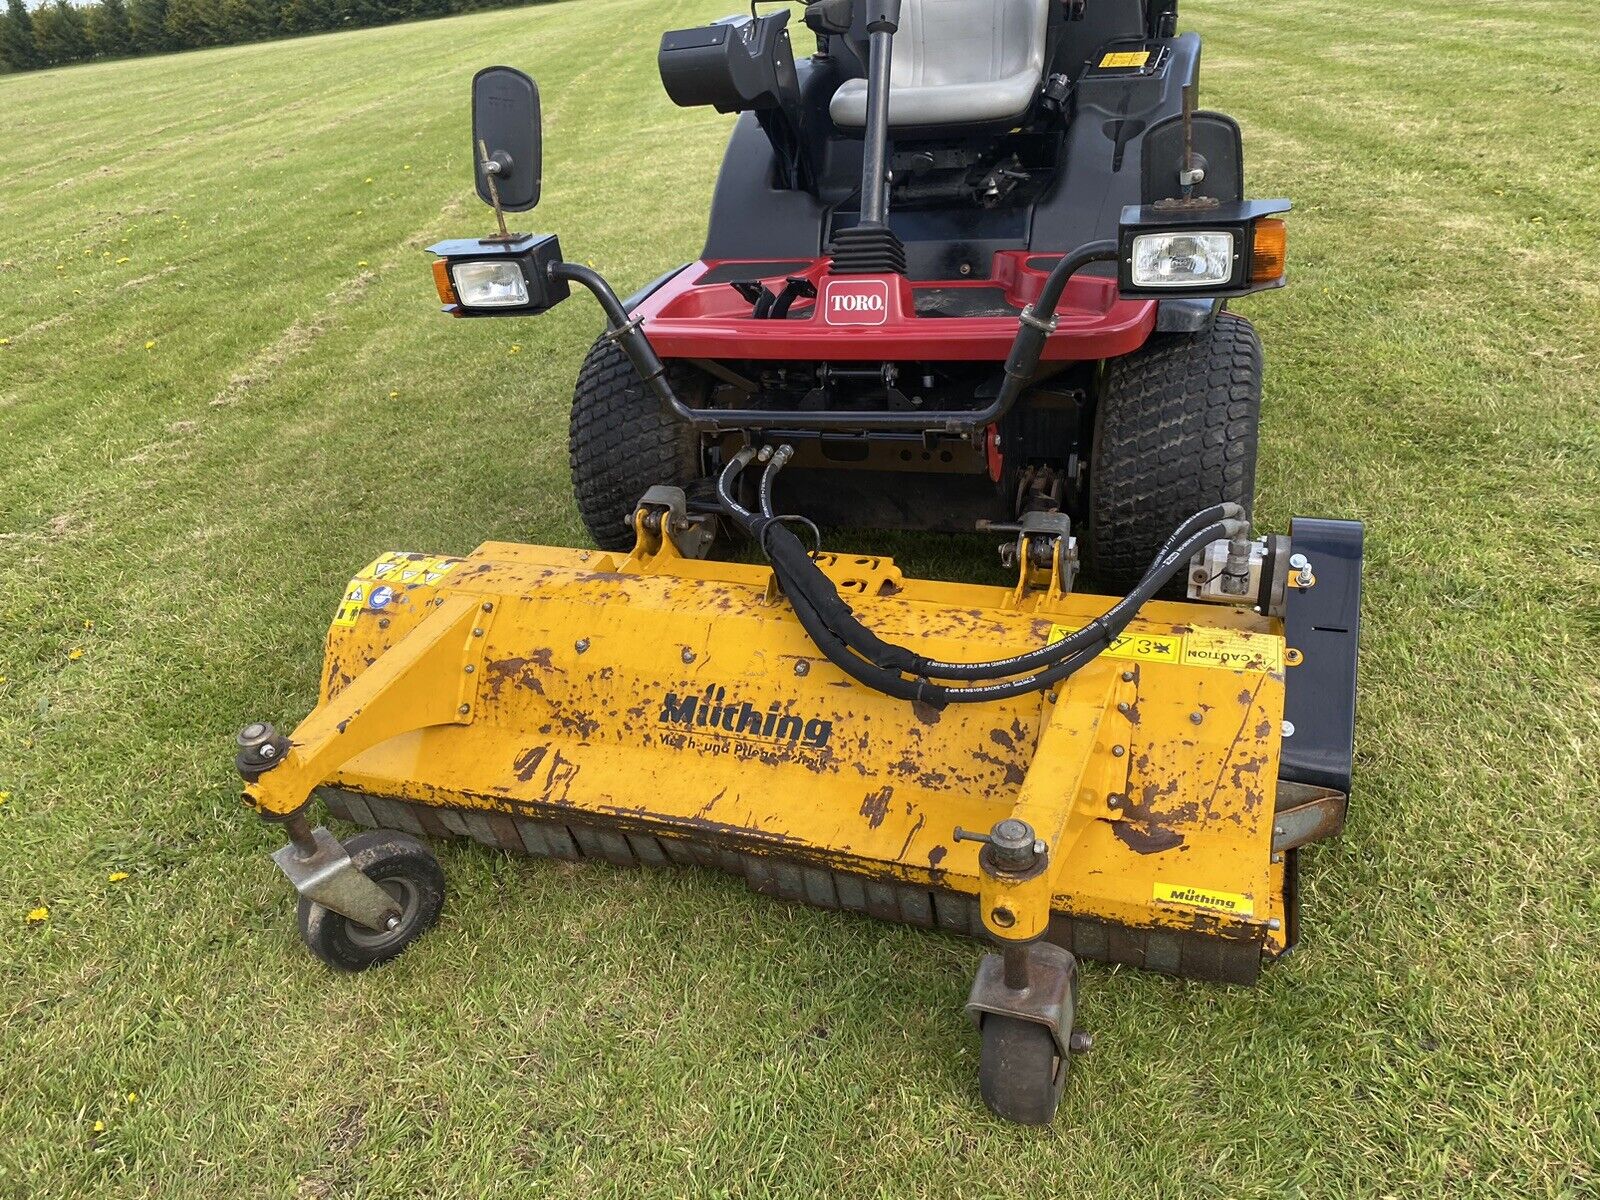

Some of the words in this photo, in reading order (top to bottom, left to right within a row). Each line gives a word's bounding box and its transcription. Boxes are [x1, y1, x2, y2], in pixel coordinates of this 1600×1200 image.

[1188, 650, 1250, 662] CAUTION
[658, 683, 833, 747] Müthing
[1170, 888, 1236, 909] Müthing
